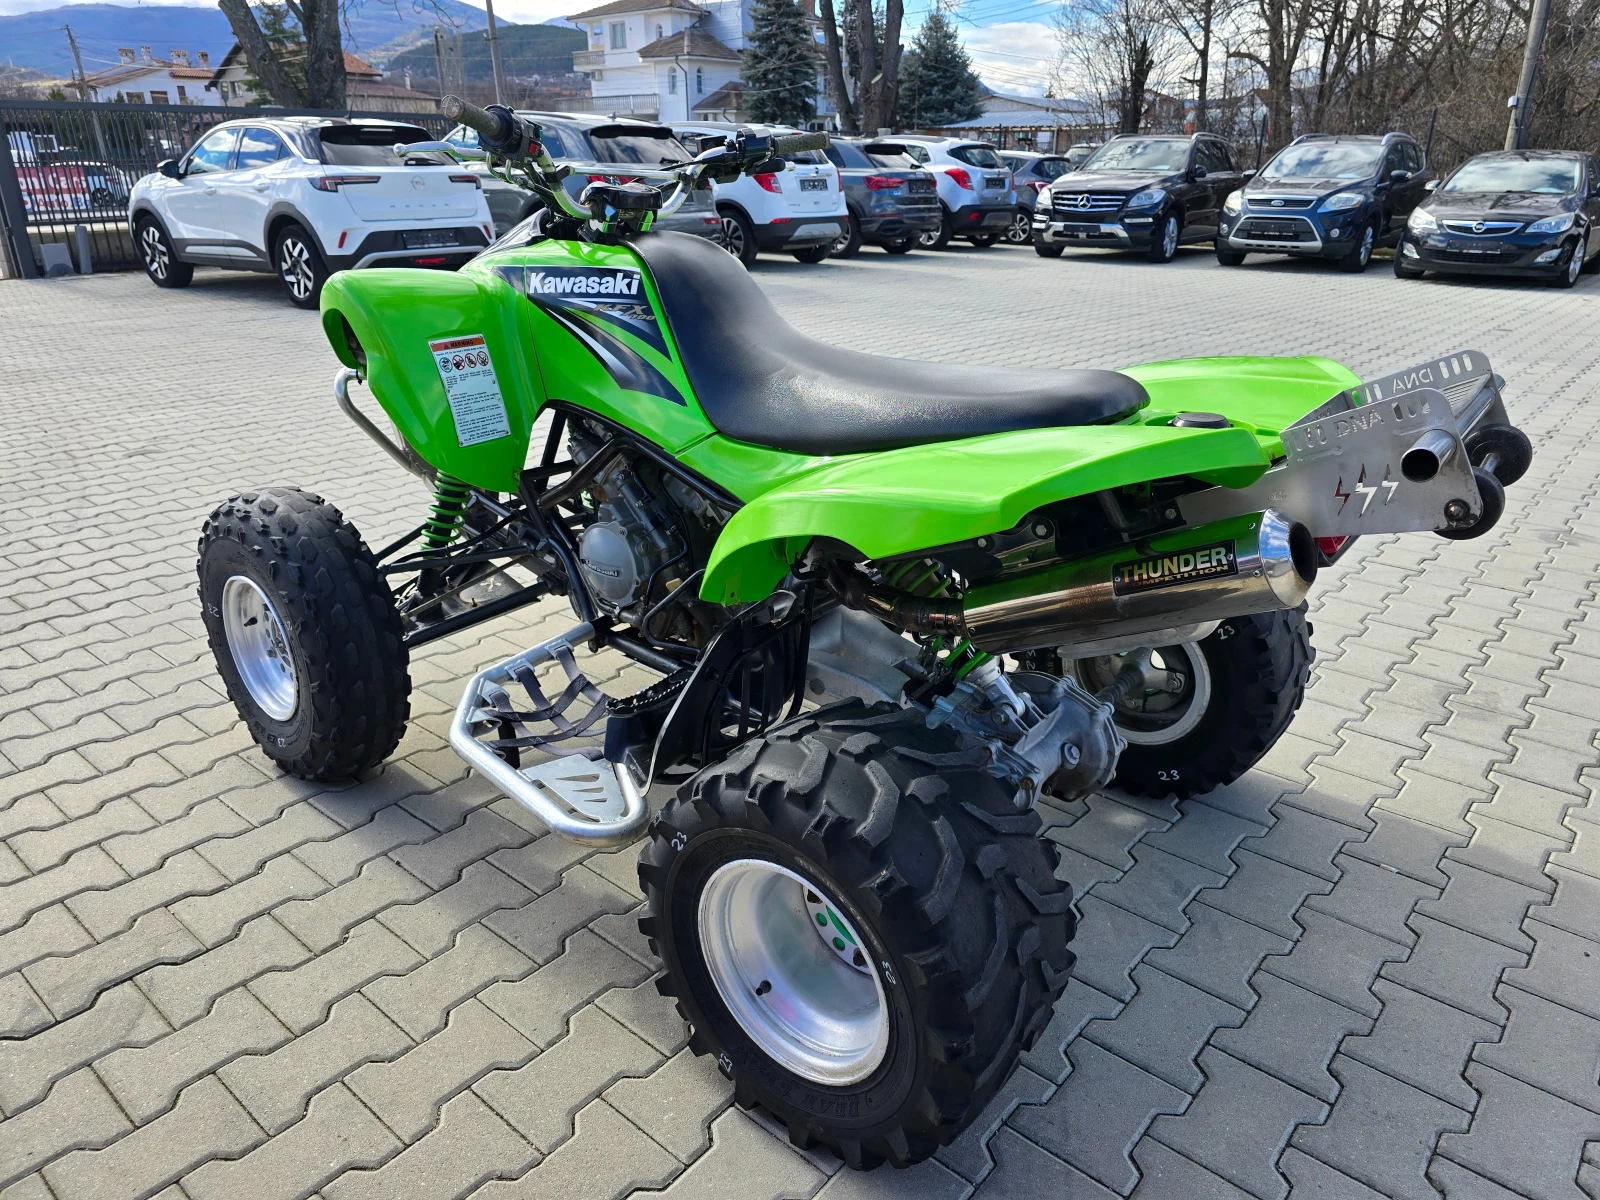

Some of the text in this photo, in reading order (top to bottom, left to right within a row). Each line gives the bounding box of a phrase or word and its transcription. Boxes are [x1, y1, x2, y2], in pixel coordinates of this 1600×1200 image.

[529, 272, 640, 295] Kawasaki
[593, 303, 648, 316] KFX
[451, 339, 474, 348] WARNING
[1333, 409, 1385, 437] DNA
[1120, 547, 1228, 583] THUNDER
[1218, 625, 1236, 640] 23
[1157, 769, 1180, 781] 23
[671, 831, 688, 852] 23
